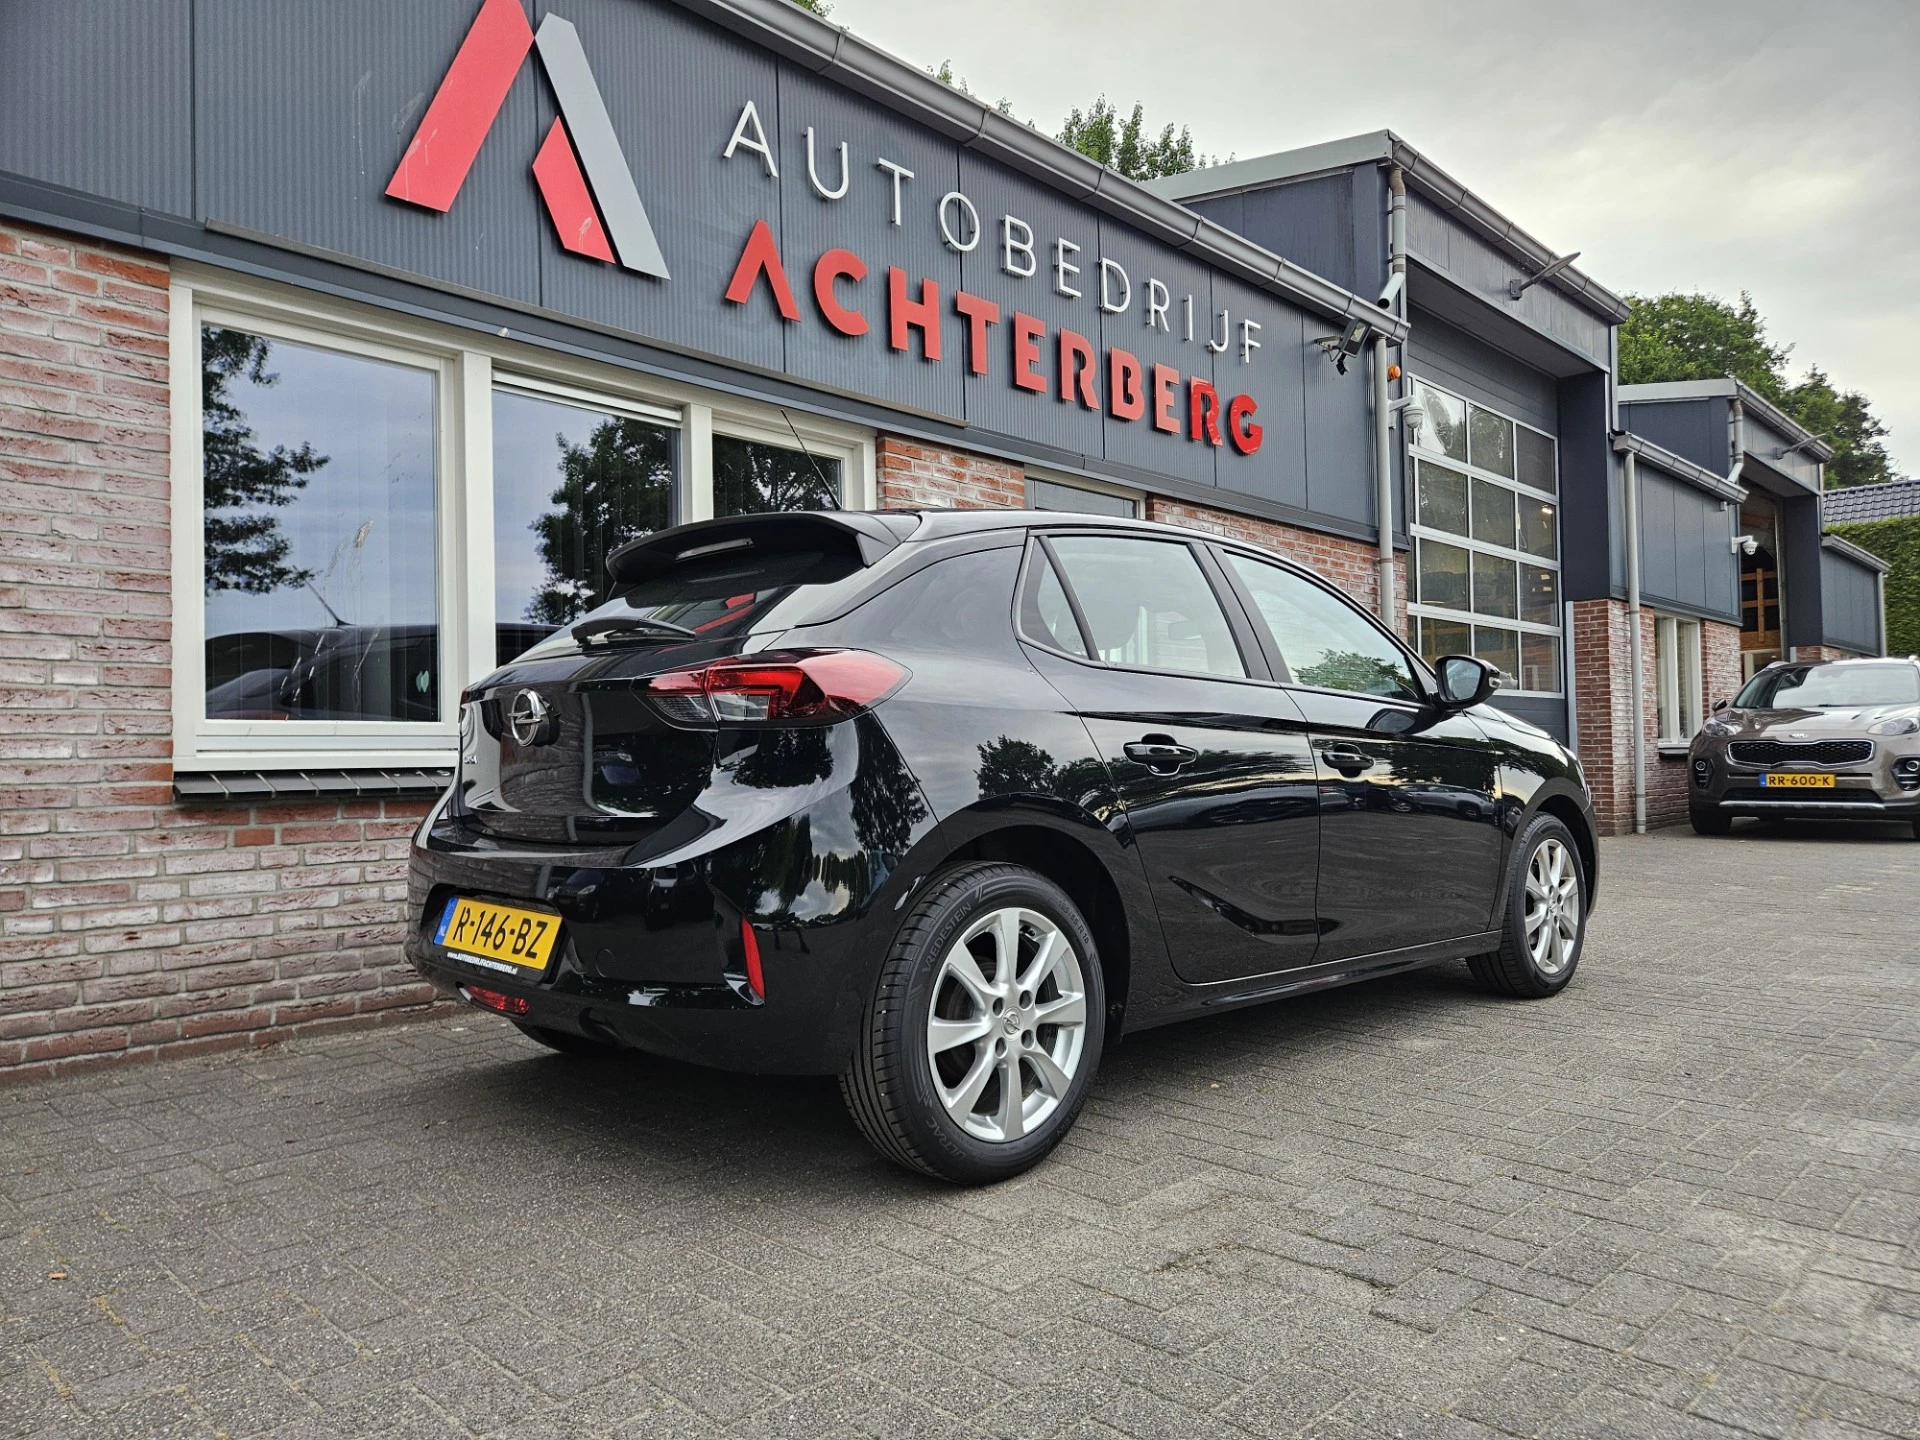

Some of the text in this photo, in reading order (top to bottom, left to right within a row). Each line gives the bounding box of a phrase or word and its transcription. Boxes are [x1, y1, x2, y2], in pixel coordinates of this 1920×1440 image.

[722, 100, 1262, 364] AUTOBEDRIJF
[725, 219, 1263, 455] ACHTERBERG
[1768, 775, 1830, 786] RR-600-K
[452, 906, 548, 960] R-146-BZ
[921, 901, 972, 973] VREDESTEIN
